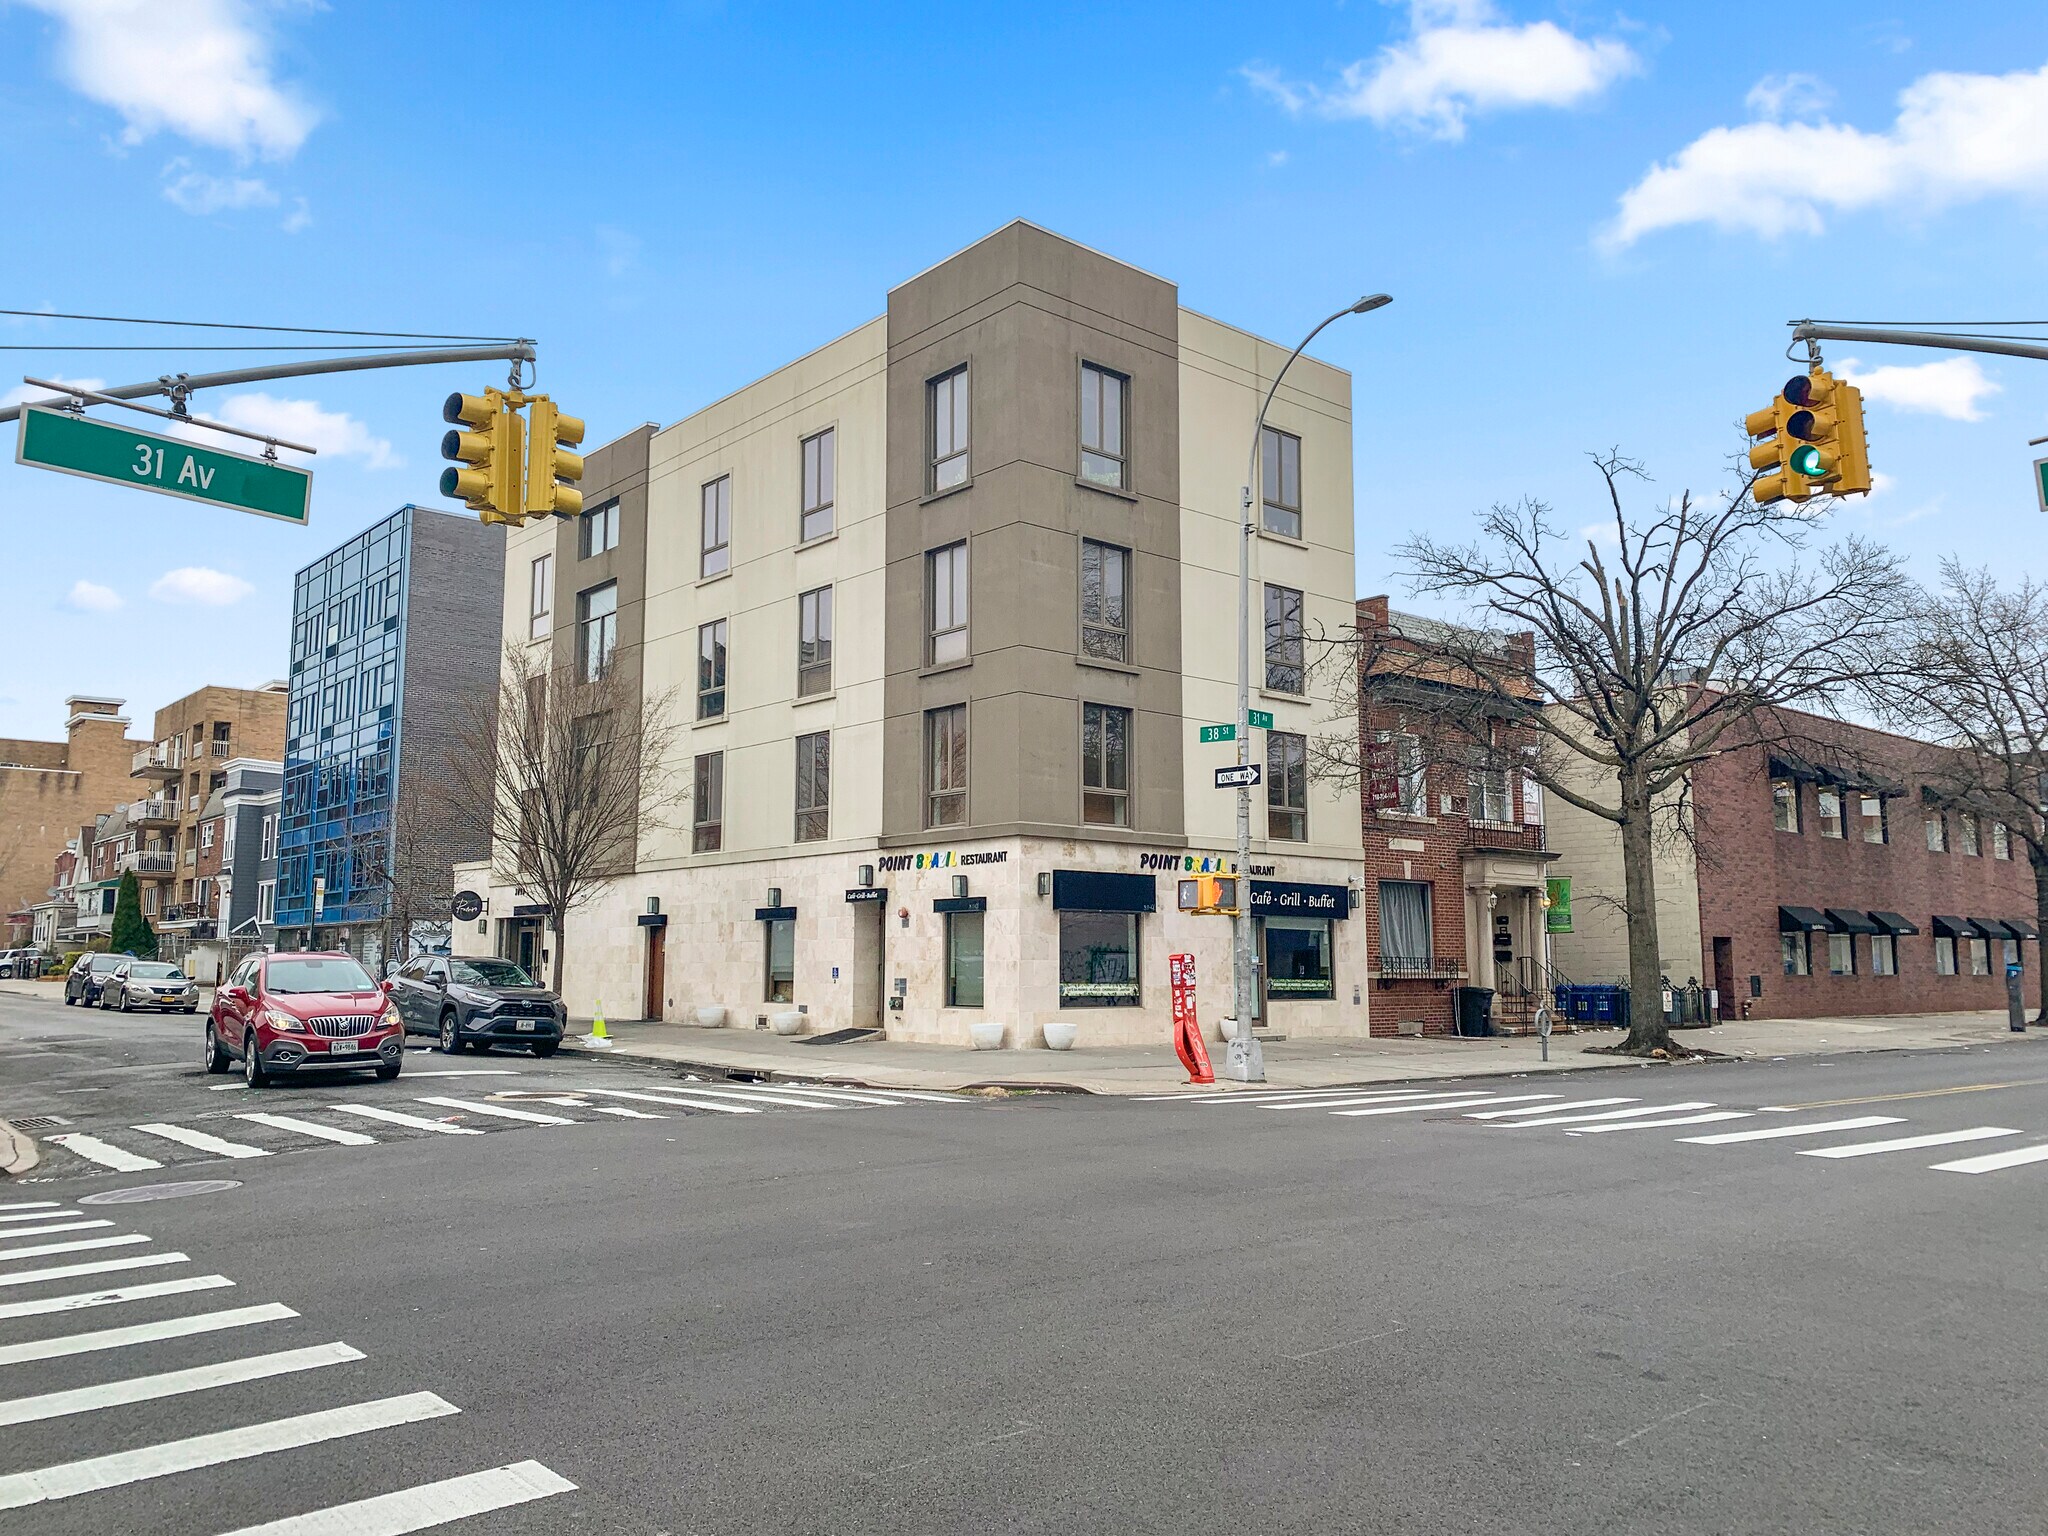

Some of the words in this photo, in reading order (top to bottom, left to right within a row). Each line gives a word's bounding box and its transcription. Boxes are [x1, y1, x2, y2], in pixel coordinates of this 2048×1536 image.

[132, 444, 164, 479] 31
[178, 455, 215, 489] Av
[1253, 712, 1260, 725] 31
[1208, 727, 1219, 741] 38
[1221, 773, 1234, 783] ONE
[1240, 771, 1254, 781] WAY
[879, 854, 914, 873] POINT
[916, 851, 957, 870] BRAZIL
[960, 851, 1008, 866] RESTAURANT
[1140, 853, 1181, 871] POINT
[1184, 855, 1228, 874] BRAZIL
[1250, 890, 1272, 905] Café
[1280, 892, 1300, 907] Grill
[1308, 894, 1336, 908] Buffet
